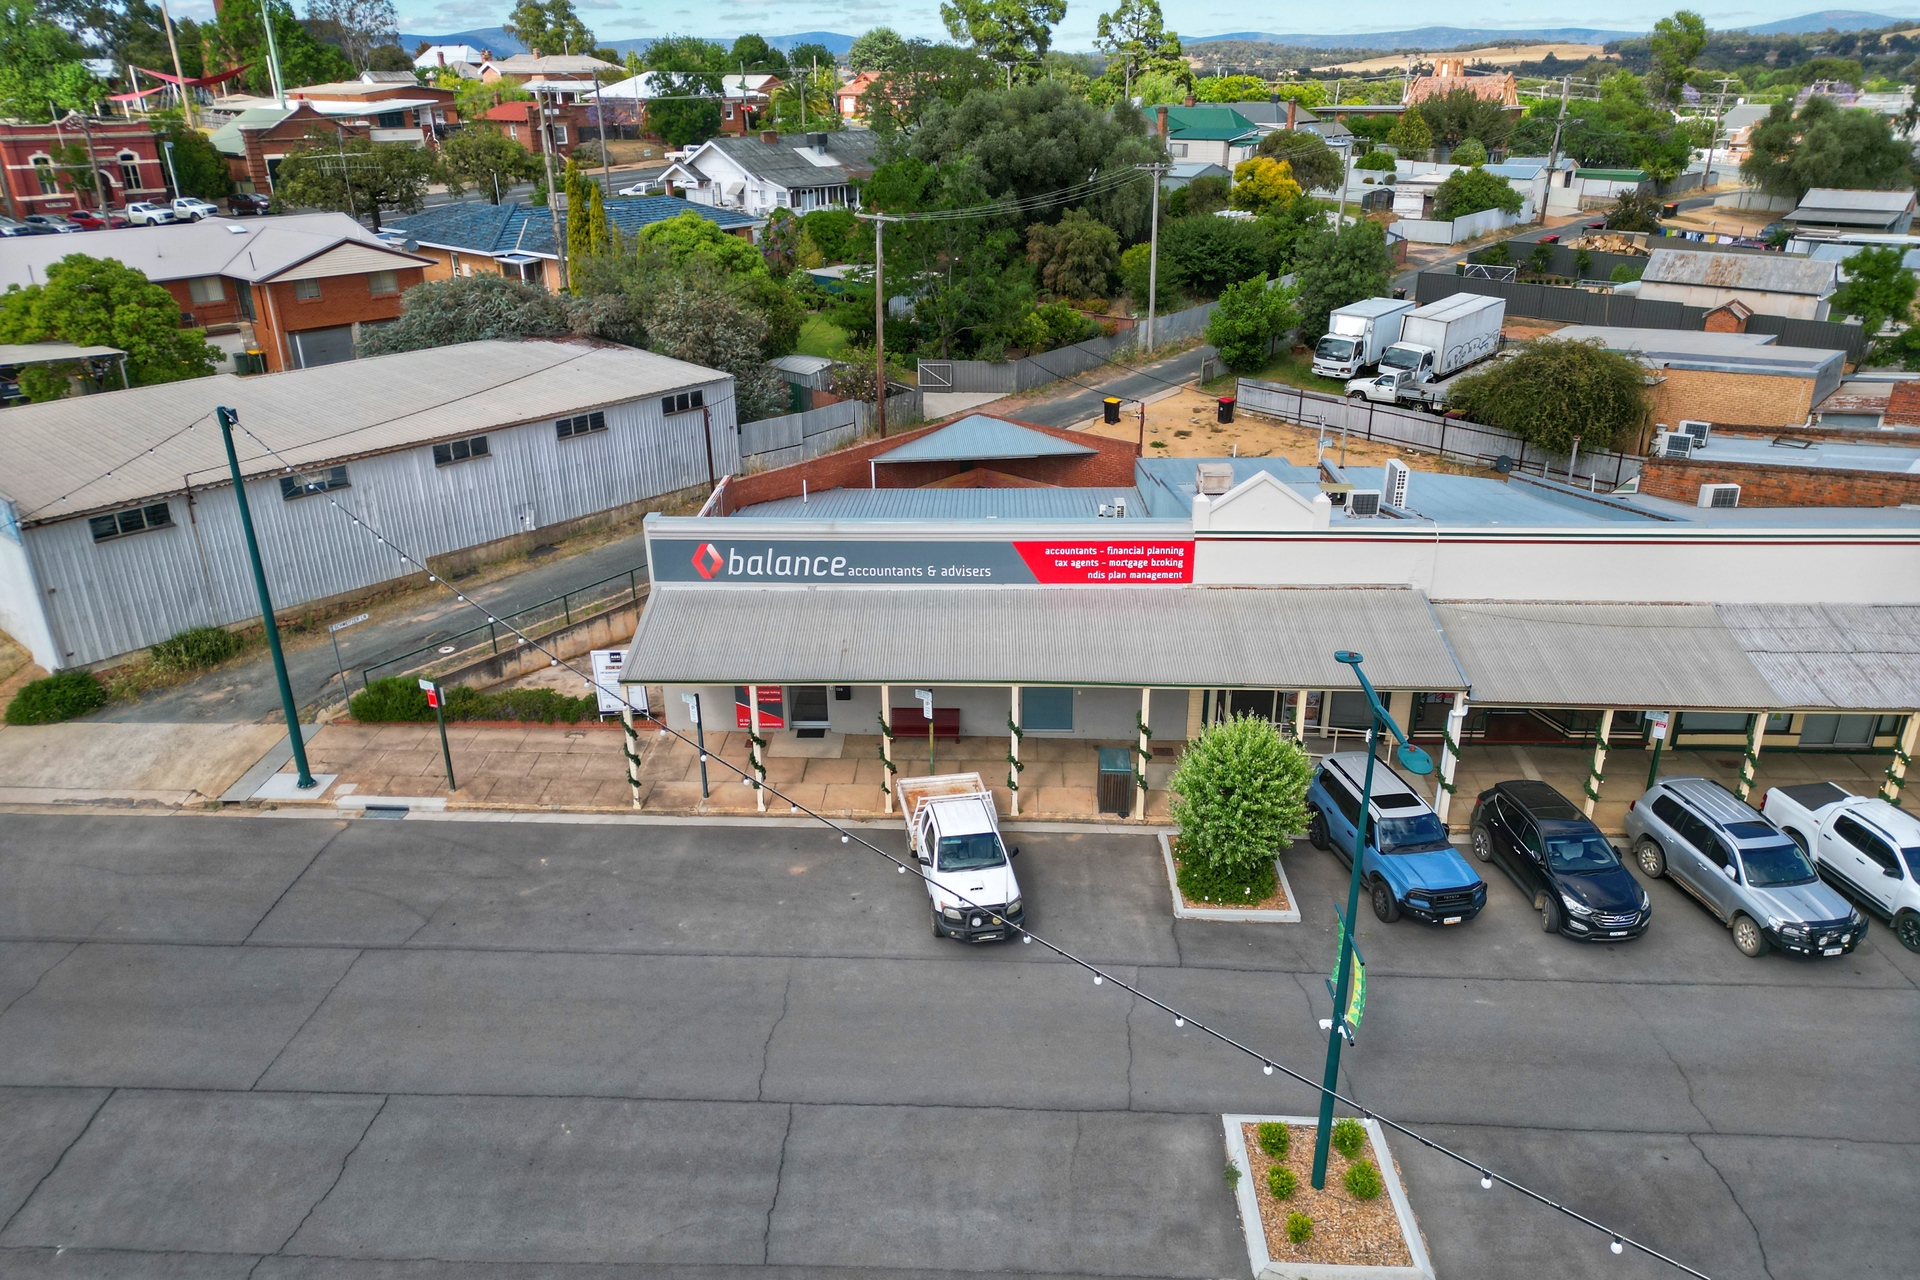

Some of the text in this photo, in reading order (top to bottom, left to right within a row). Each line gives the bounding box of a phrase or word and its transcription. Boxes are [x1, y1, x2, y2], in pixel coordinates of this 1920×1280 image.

[1045, 547, 1098, 555] accountants
[1107, 546, 1144, 555] financial
[1147, 547, 1184, 557] planning
[728, 548, 992, 578] balance accountants & advisers
[1055, 559, 1067, 567] tax
[1071, 560, 1099, 568] agents
[1109, 559, 1149, 568] mortgage
[1151, 558, 1184, 568] broking
[1088, 571, 1183, 580] ndis plan management
